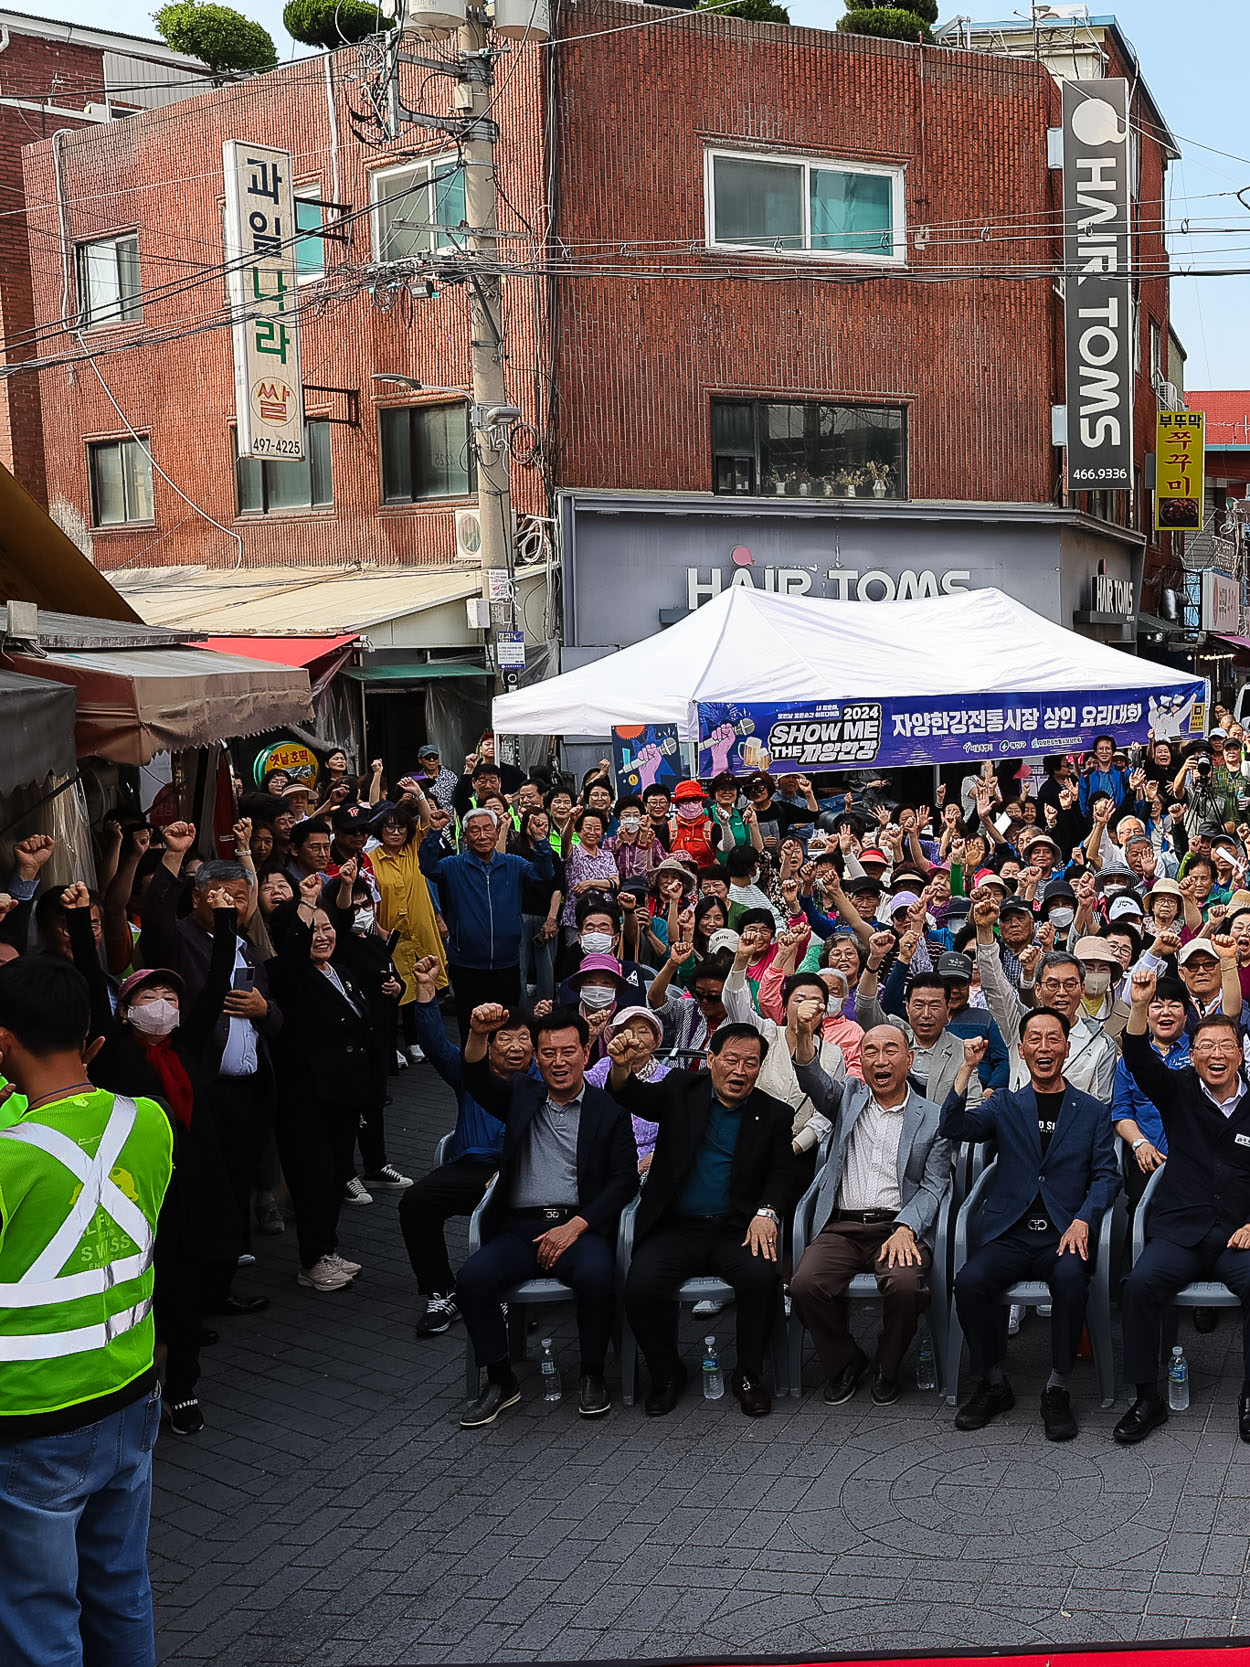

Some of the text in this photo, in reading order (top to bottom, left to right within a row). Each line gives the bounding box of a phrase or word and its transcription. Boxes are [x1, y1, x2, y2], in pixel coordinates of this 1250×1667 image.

[247, 158, 291, 365] 과일나라
[1076, 157, 1121, 449] HAIR TOMS
[257, 383, 291, 422] 쌀
[1159, 414, 1203, 430] 부뚜막
[253, 437, 300, 455] 497-4225
[1072, 468, 1128, 480] 466.9336
[1164, 430, 1194, 497] 쭈꾸미
[1114, 580, 1134, 614] TOMS
[843, 705, 879, 720] 2024
[891, 702, 1143, 737] 자양한강전통시장 상인 요리대회
[771, 720, 880, 744] SHOW ME
[772, 740, 878, 763] THE 자양한강
